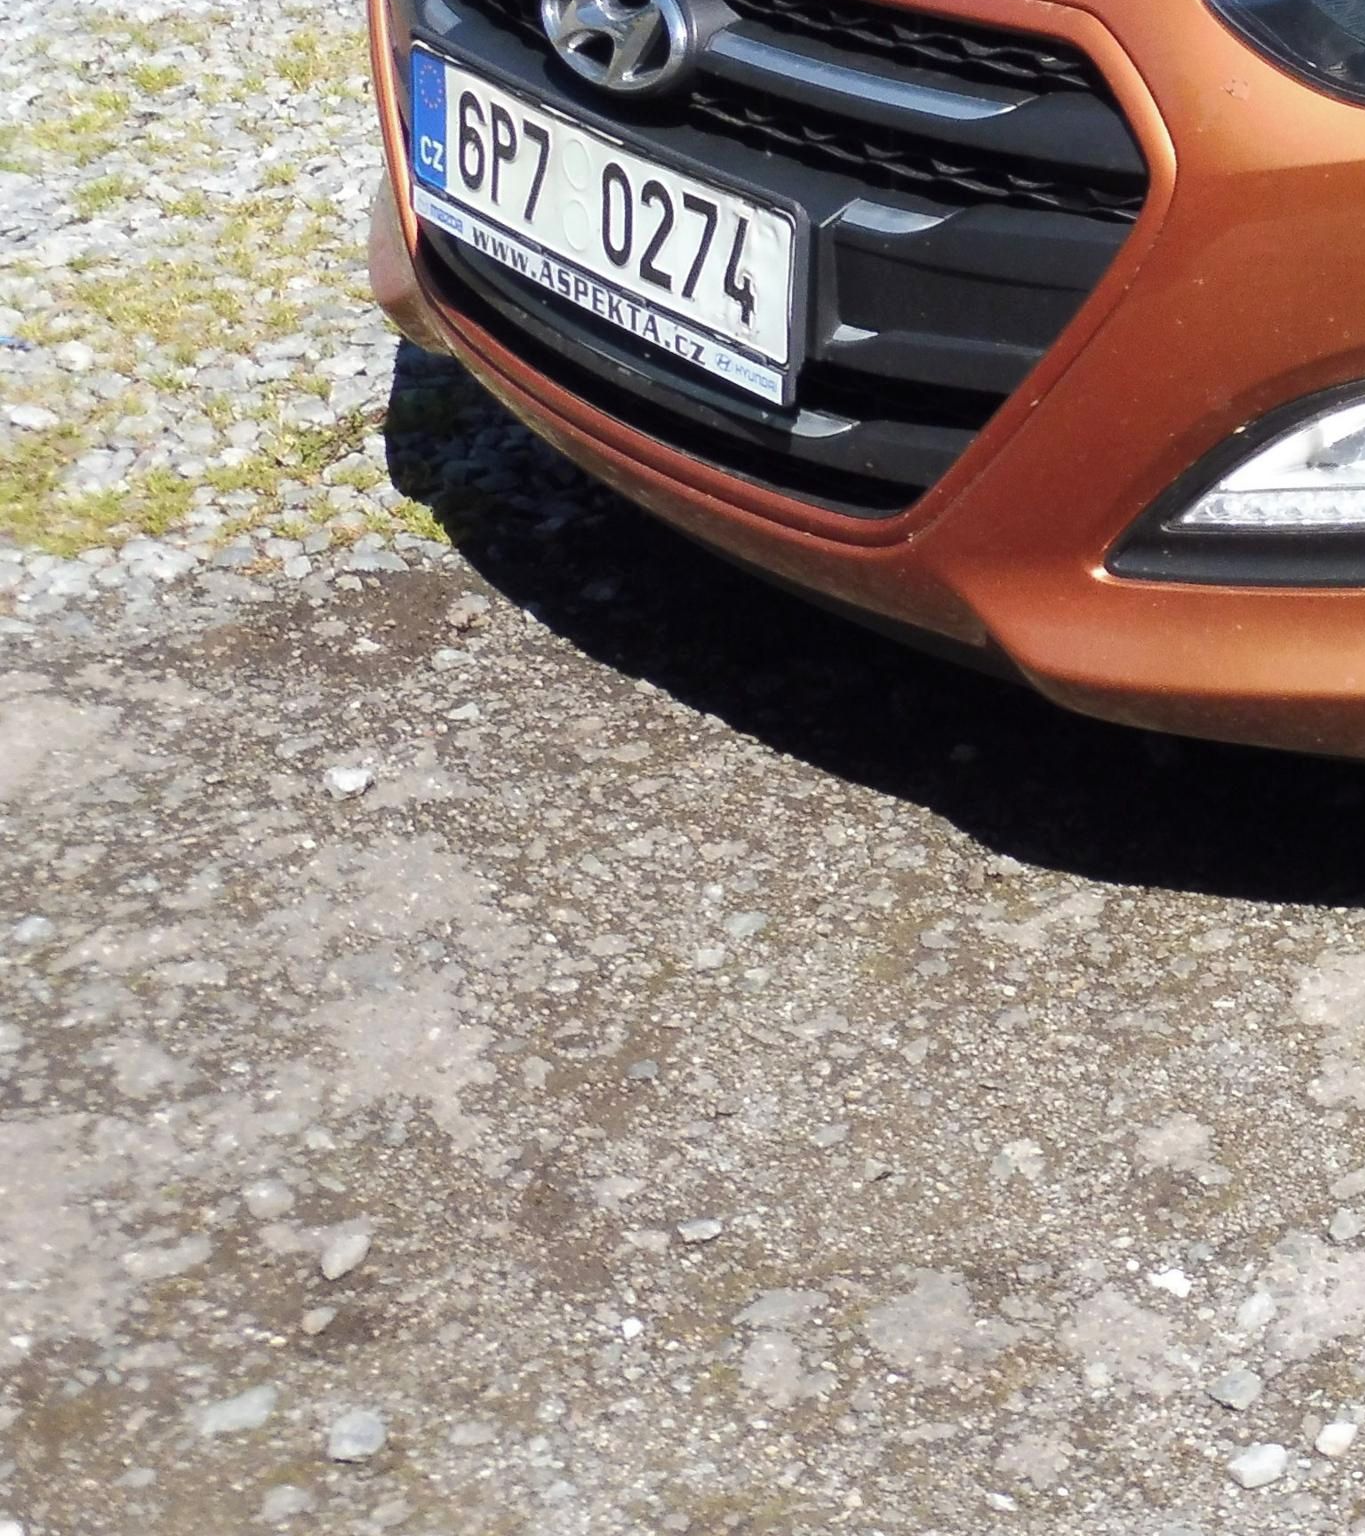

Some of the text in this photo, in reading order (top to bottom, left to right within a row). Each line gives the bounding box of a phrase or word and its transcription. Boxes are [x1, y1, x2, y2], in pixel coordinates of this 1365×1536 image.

[420, 90, 757, 326] CZ 6P7 0274
